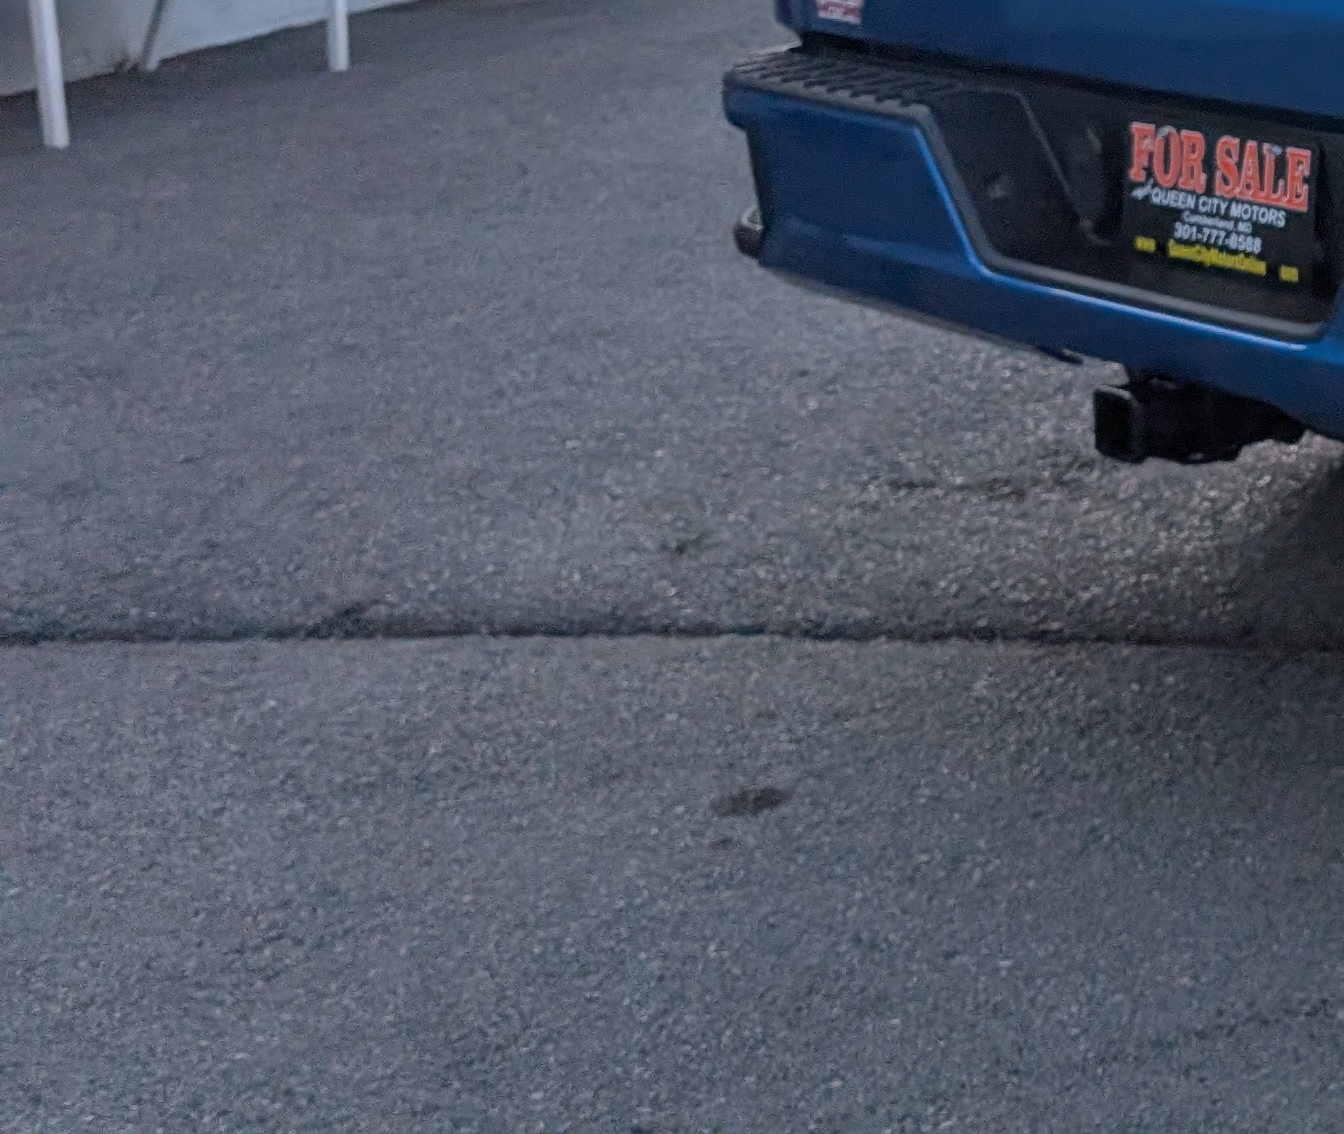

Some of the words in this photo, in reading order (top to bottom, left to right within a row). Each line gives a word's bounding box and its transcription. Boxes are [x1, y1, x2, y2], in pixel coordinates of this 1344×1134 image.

[1130, 122, 1207, 194] FOR
[1215, 134, 1312, 213] SALE
[1151, 189, 1196, 210] QUEEN
[1199, 196, 1229, 216] CITY
[1231, 201, 1287, 229] MOTORS
[1173, 221, 1263, 255] 301-777-8588
